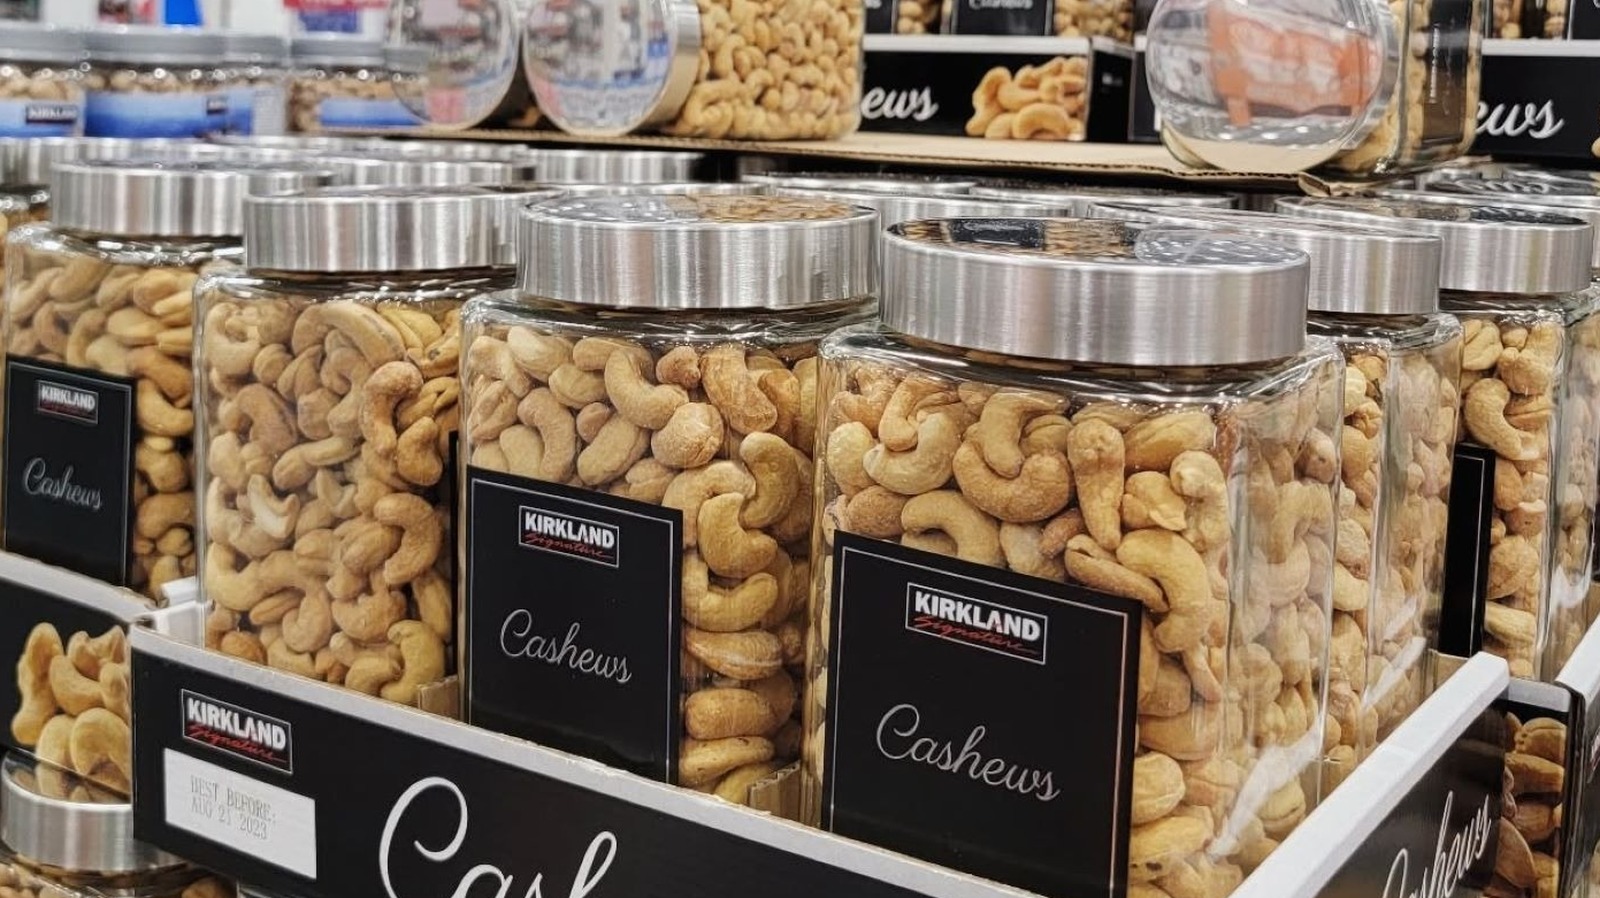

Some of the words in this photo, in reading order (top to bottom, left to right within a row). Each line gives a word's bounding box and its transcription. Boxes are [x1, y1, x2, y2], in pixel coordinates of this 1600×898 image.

[41, 386, 96, 411] KIRKLAND
[24, 457, 102, 509] Cashews
[525, 511, 615, 548] KIRKLAND
[915, 591, 1040, 641] KIRKLAND
[500, 608, 633, 684] Cashews
[187, 698, 286, 750] KIRKLAND
[876, 704, 1060, 801] Cashews
[191, 795, 212, 819] AUG
[218, 803, 232, 826] 21
[239, 812, 267, 840] 2023
[1380, 789, 1492, 898] hews
